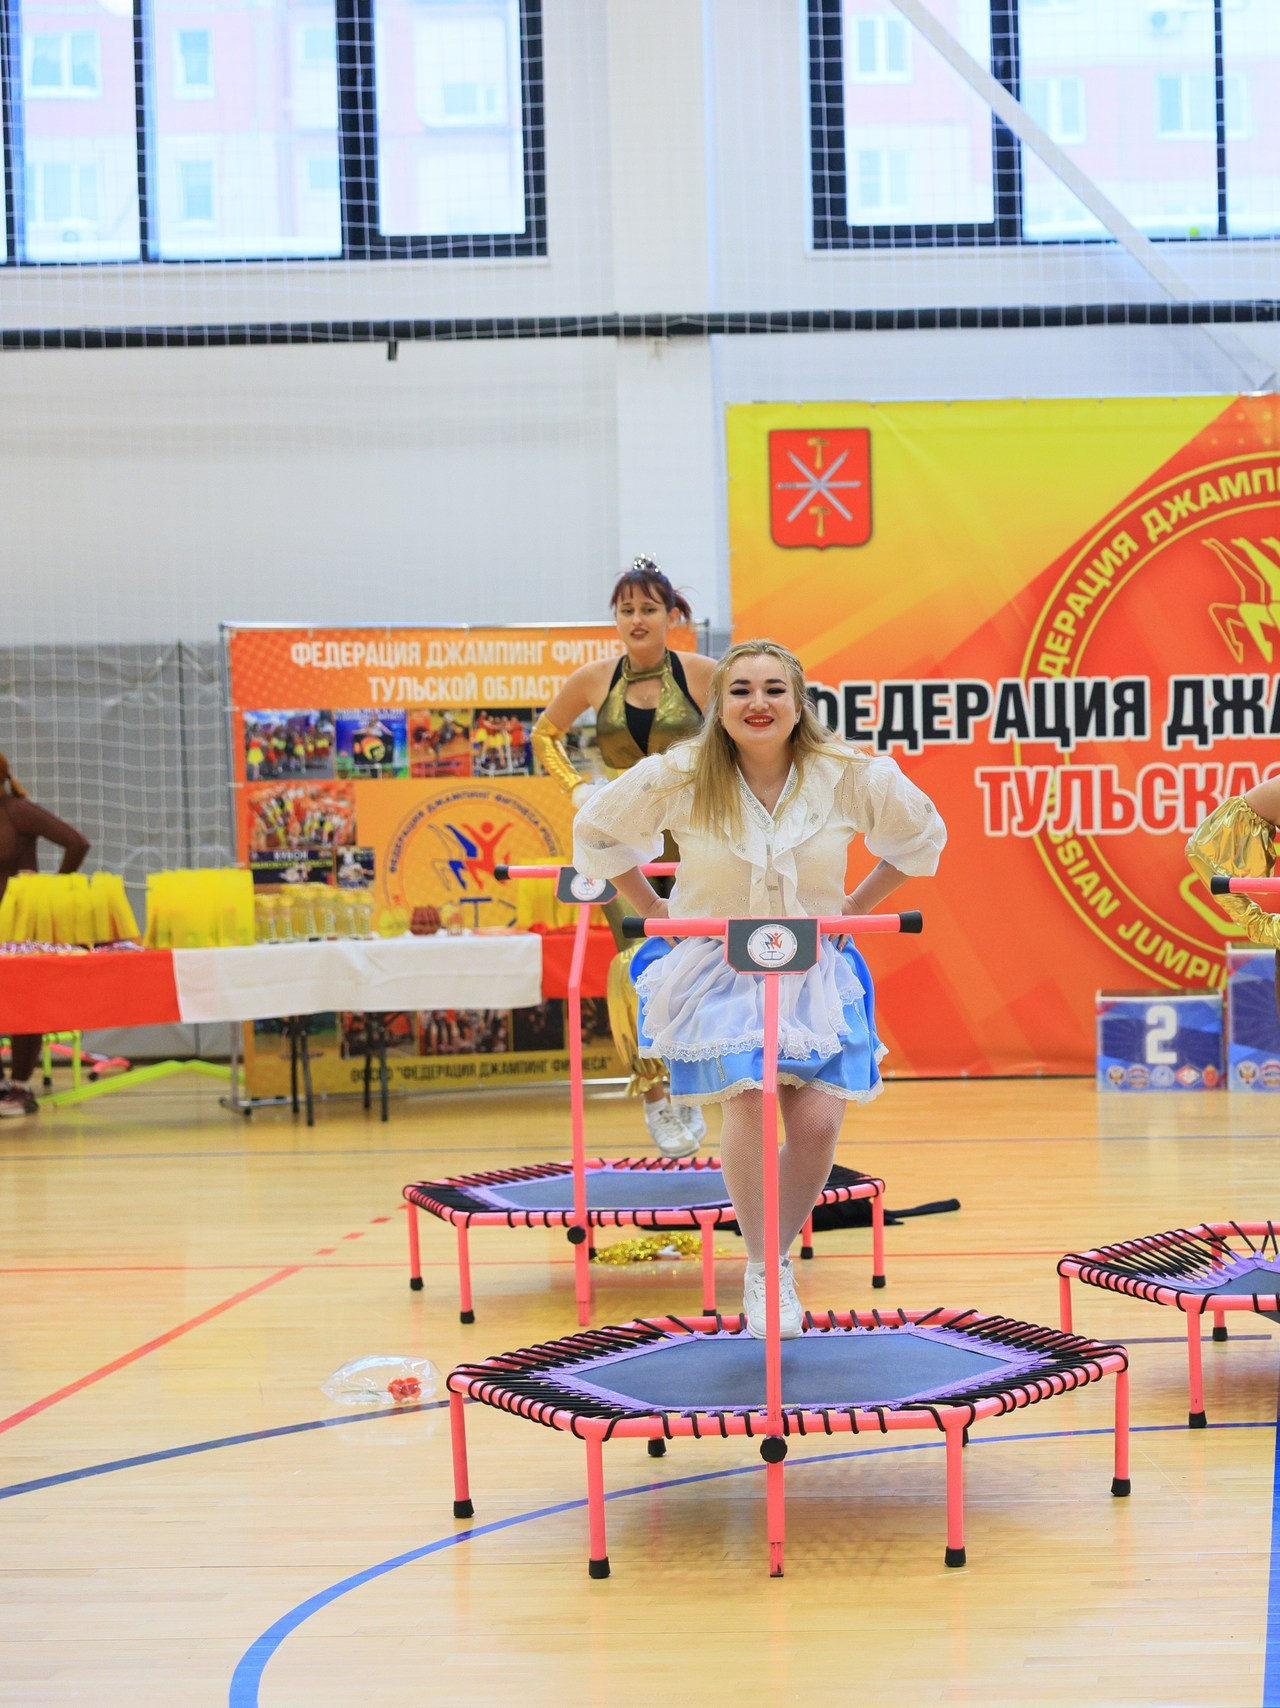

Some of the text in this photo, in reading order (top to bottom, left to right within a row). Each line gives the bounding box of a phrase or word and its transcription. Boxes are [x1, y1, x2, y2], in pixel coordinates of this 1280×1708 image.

[1038, 531, 1139, 677] ДЕРАЦИЯ
[290, 638, 628, 669] ФЕДЕРАЦИЯ ДЖАМПИНГ ФИТНЕ
[367, 672, 568, 703] ТУЛЬСКОЙ ОБЛАСТ
[1050, 829, 1120, 918] SIAN
[1117, 919, 1227, 990] JUMPI
[1145, 1005, 1177, 1064] 2
